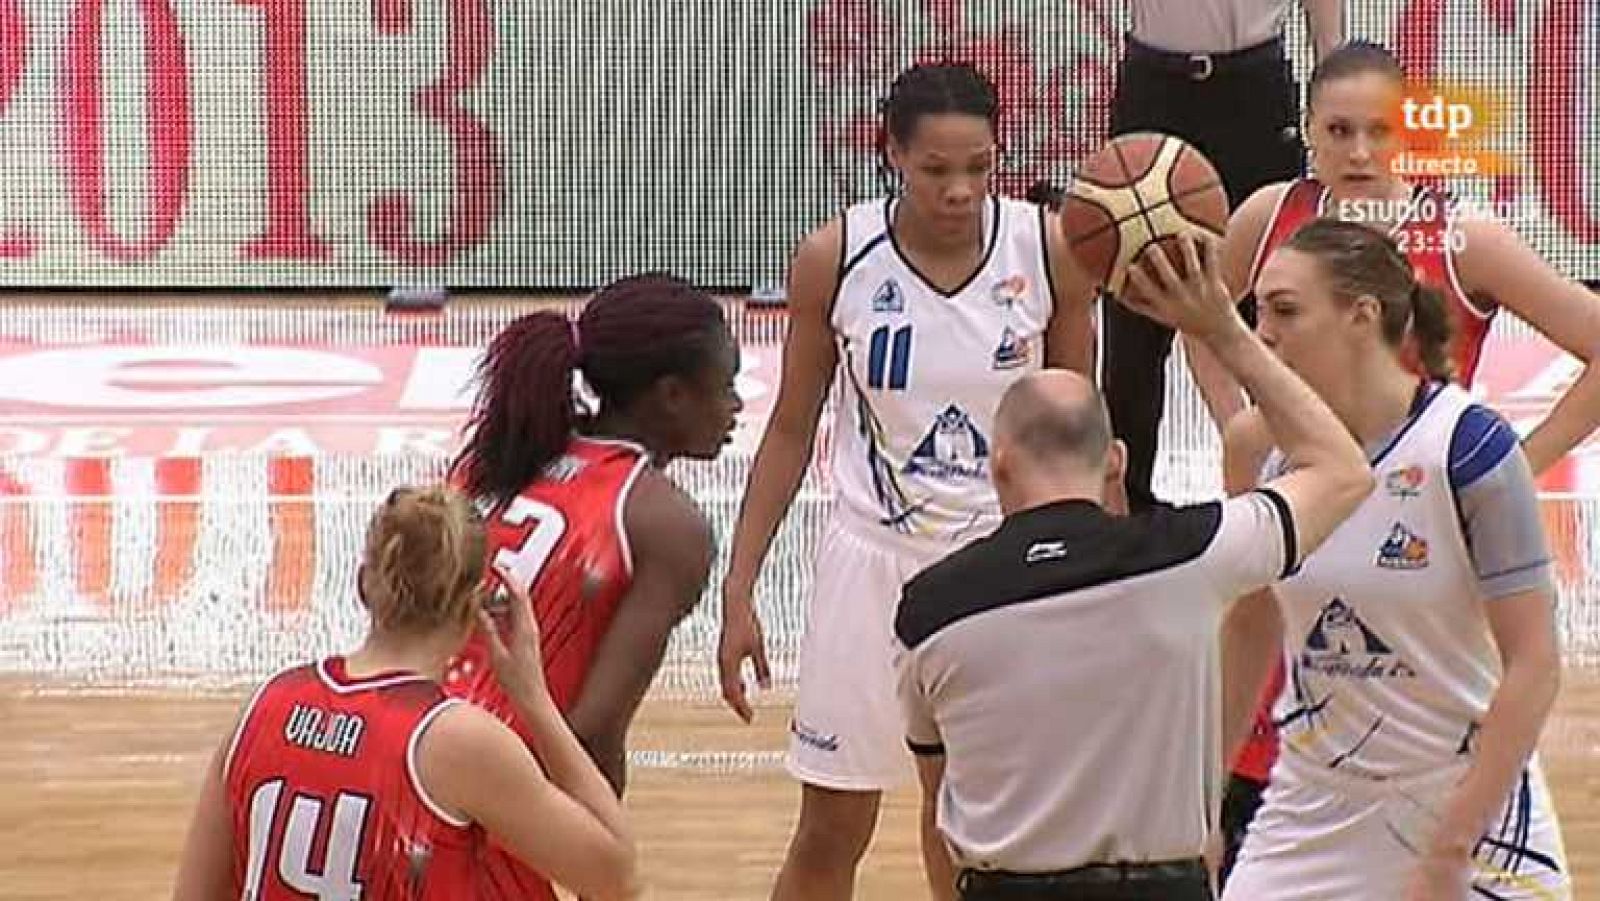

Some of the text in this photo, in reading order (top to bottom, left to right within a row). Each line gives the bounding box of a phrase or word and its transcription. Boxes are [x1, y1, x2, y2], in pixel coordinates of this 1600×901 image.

[867, 324, 913, 391] 11
[284, 703, 364, 756] VAJDA
[242, 778, 372, 900] 14
